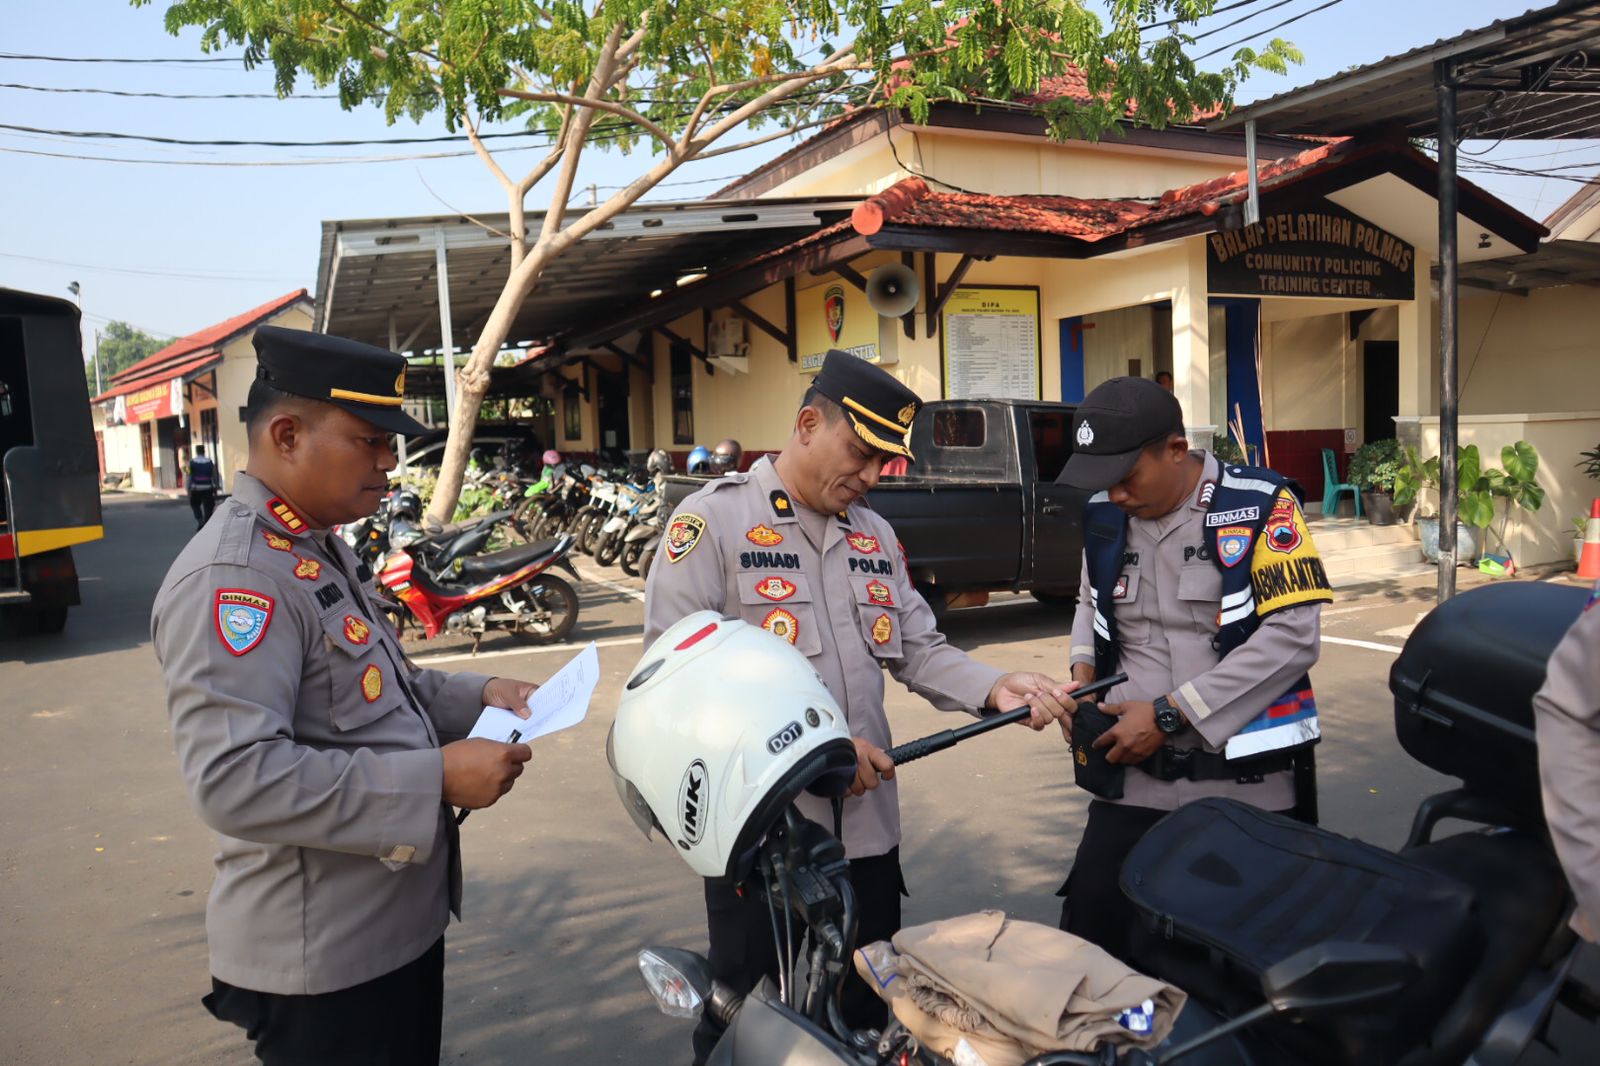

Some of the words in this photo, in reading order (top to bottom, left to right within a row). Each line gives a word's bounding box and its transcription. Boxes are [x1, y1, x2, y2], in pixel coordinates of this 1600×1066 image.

[1265, 213, 1351, 247] PELATIHAN
[1354, 223, 1411, 272] POLMAS
[1245, 253, 1321, 273] COMMUNITY
[1325, 258, 1381, 276] POLICING
[1259, 274, 1319, 293] TRAINING
[1322, 278, 1371, 294] CENTER
[1210, 509, 1255, 524] BINMAS
[739, 551, 801, 569] SUHADI
[848, 557, 893, 576] POLRI
[221, 594, 268, 608] BINMAS
[770, 723, 799, 752] DOT
[684, 770, 702, 838] INK
